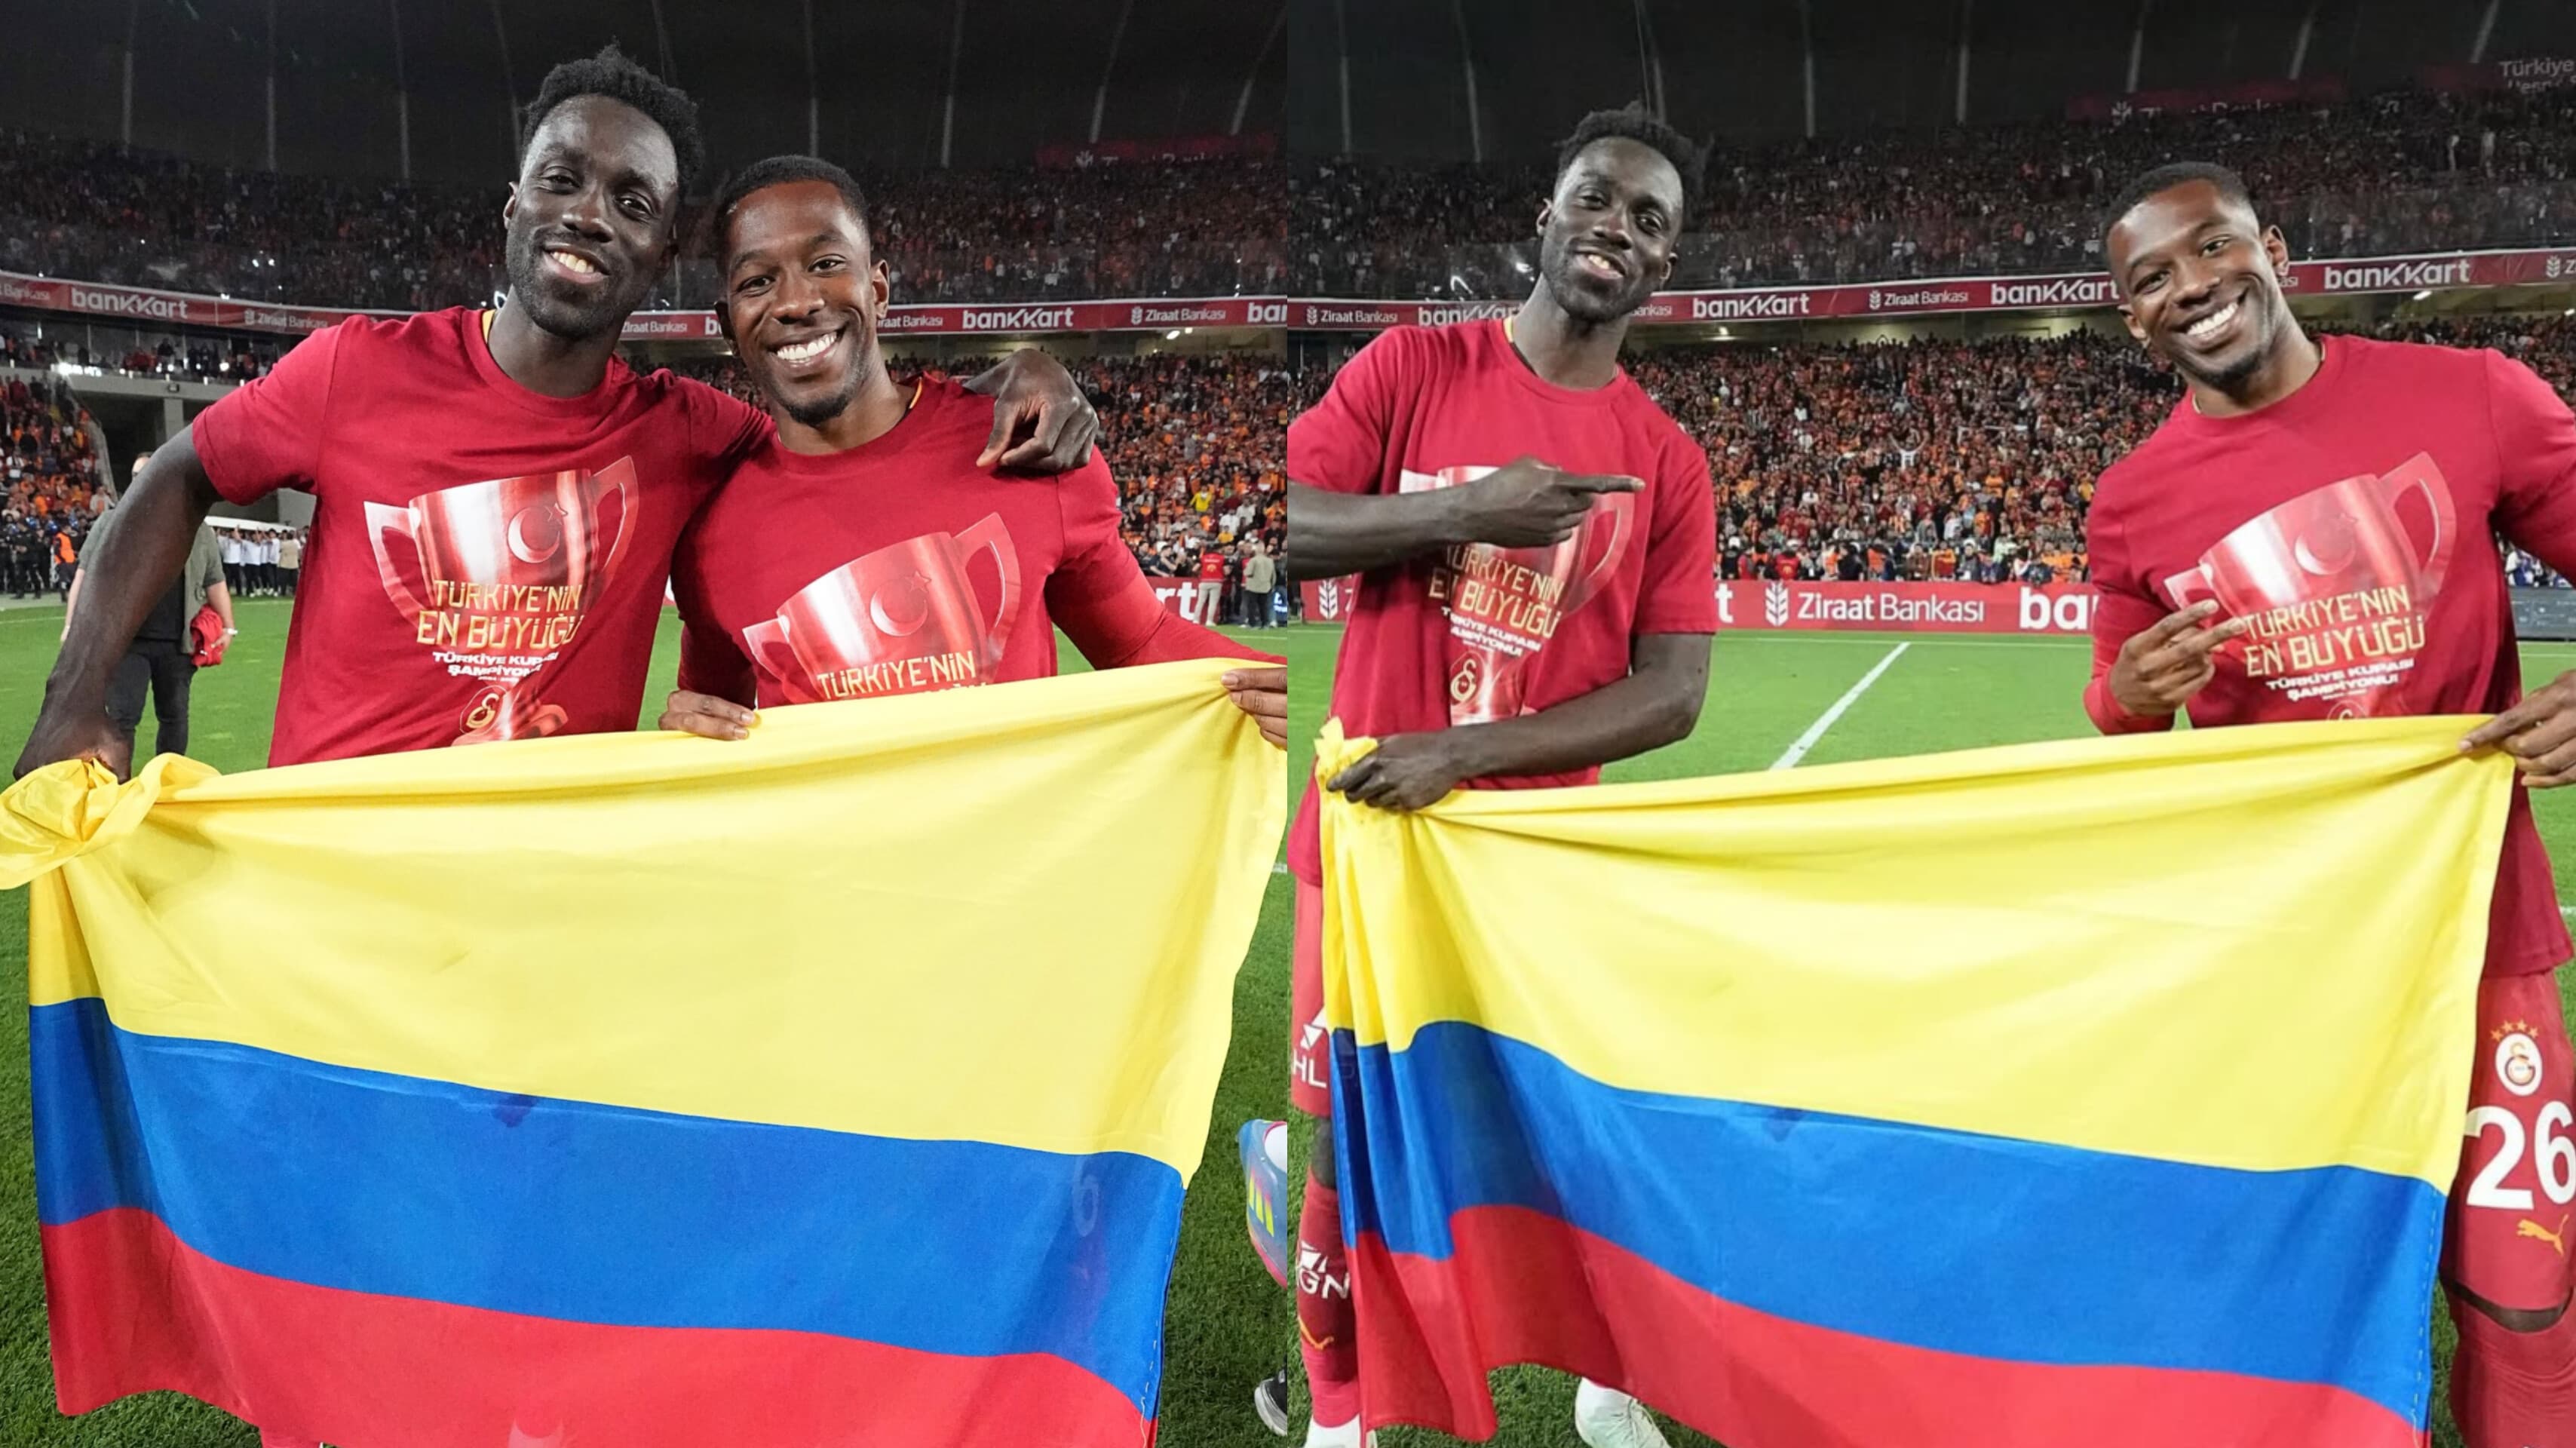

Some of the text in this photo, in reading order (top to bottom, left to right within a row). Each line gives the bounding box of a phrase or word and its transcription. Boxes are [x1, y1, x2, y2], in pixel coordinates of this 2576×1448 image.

[2499, 58, 2574, 77] Türkiye
[1884, 290, 1969, 306] Ziraat Bankası
[878, 314, 943, 328] iraat Bankası
[1145, 308, 1226, 322] Ziraat Bankası
[1320, 310, 1397, 323] Ziraat Bankası
[650, 321, 688, 333] Bankası
[1798, 591, 1983, 622] Ziraat Bankası
[416, 610, 585, 649] EN BÜYÜĞÜ
[2243, 640, 2285, 677] EN
[2464, 1100, 2576, 1210] 26
